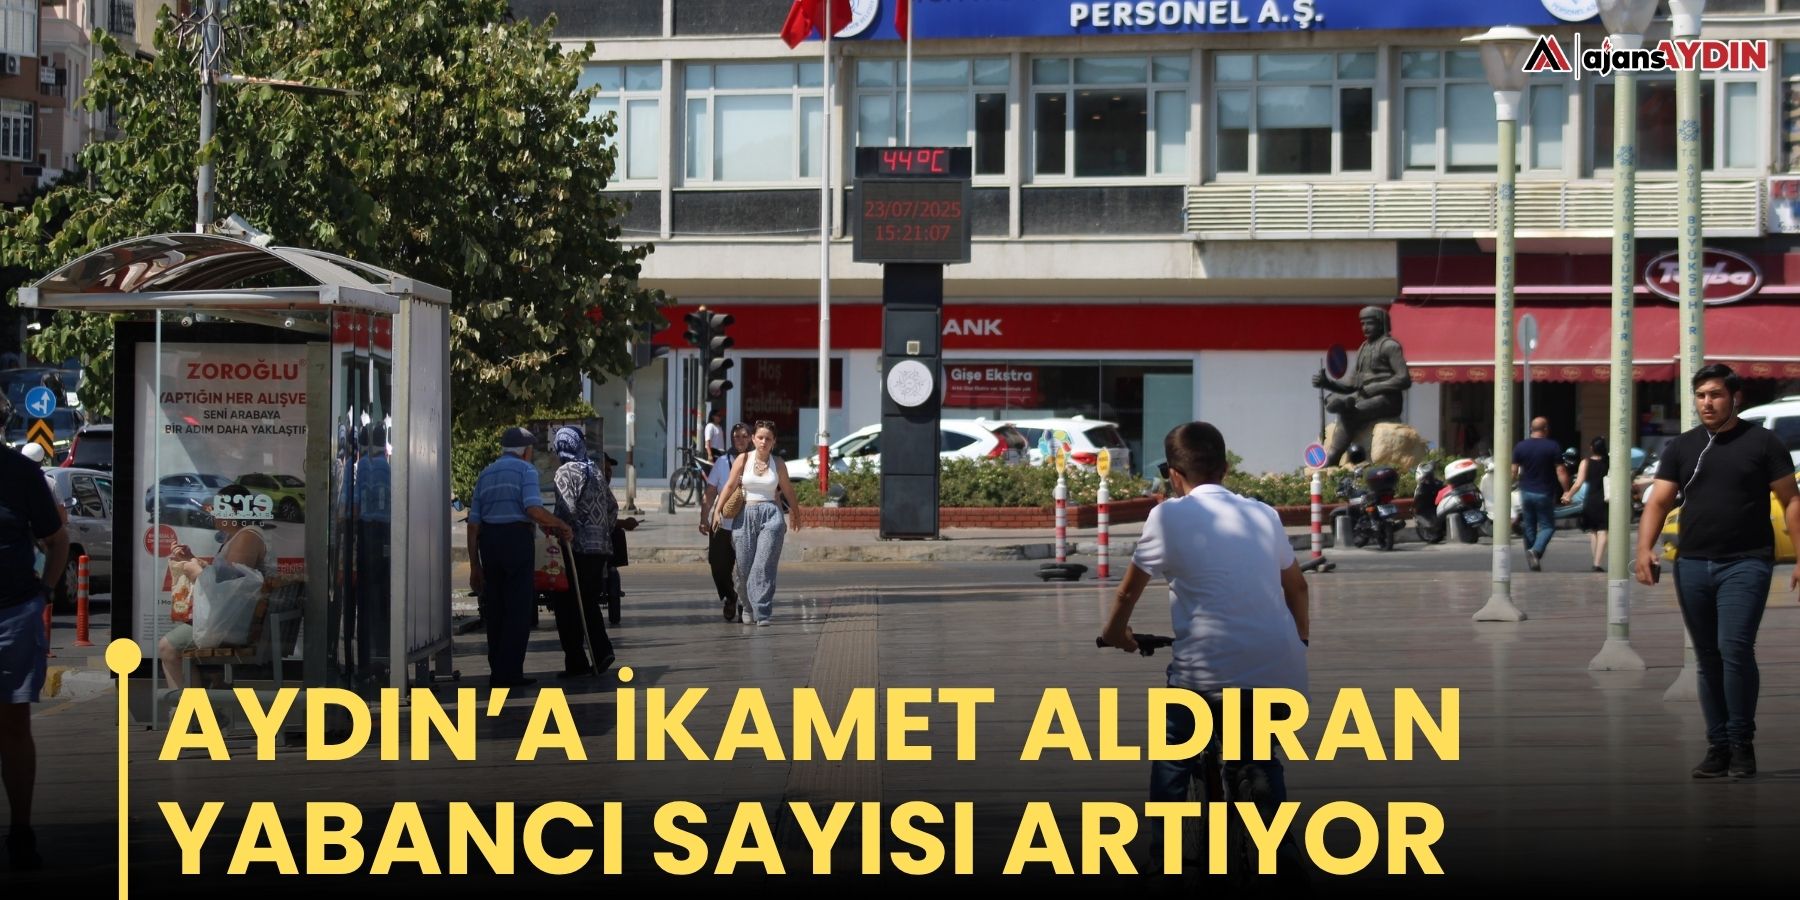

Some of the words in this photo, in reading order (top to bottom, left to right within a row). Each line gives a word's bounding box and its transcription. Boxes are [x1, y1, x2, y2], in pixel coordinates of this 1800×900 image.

[1070, 1, 1248, 27] PERSONEL
[1257, 0, 1325, 30] A.Ş.
[1687, 163, 1697, 204] AYDIN
[864, 201, 962, 220] 23/07/2025
[875, 224, 952, 241] 15:21:07
[758, 358, 782, 385] Hoş
[951, 369, 982, 384] Gişe
[986, 369, 1033, 382] Ekstra
[225, 392, 253, 404] HER
[203, 407, 228, 420] SENİ
[230, 410, 281, 420] ARABAYA
[165, 422, 182, 434] BİR
[185, 425, 214, 434] ADIM
[217, 425, 248, 434] DAHA
